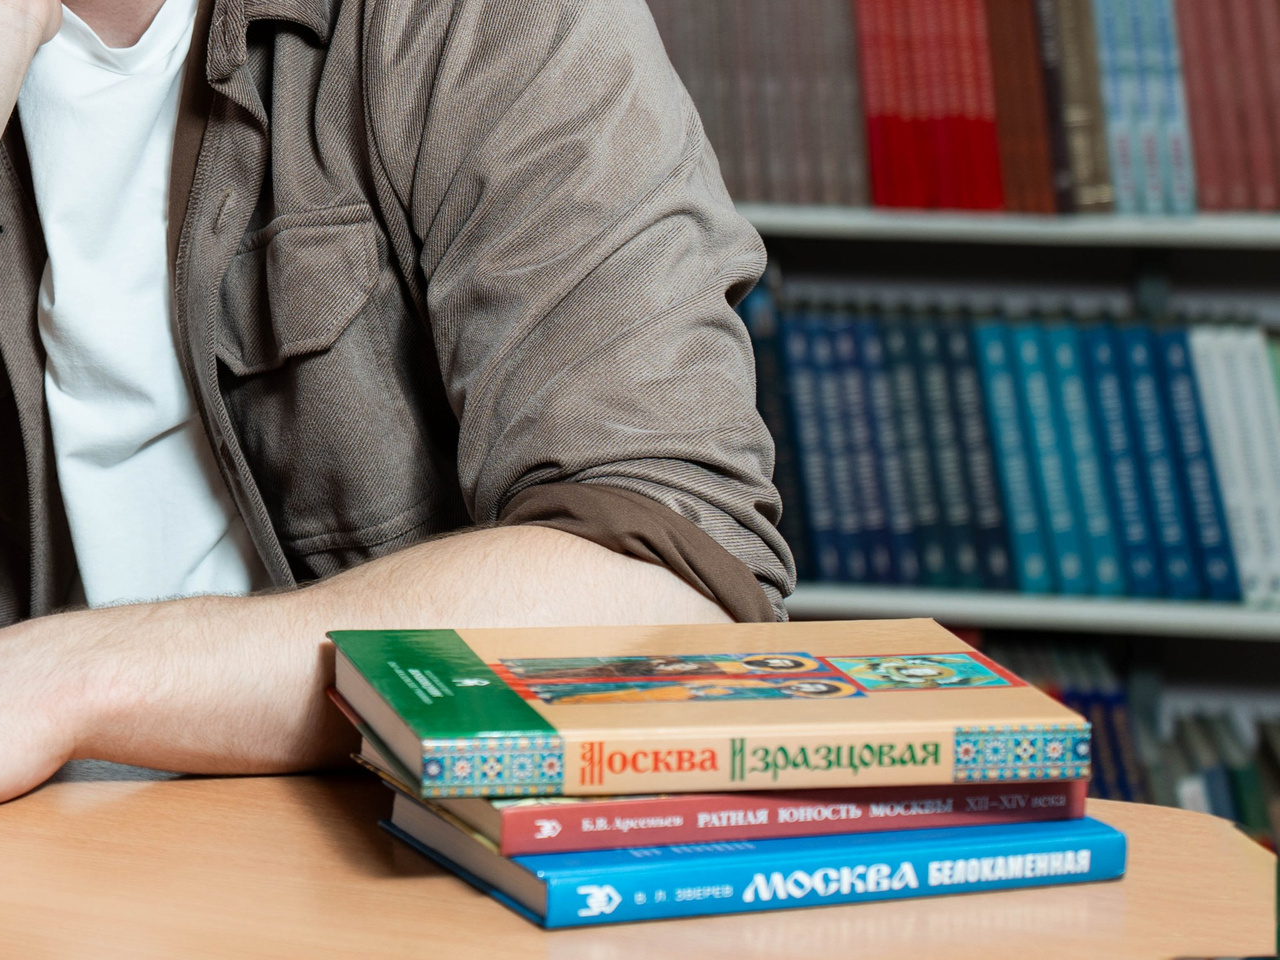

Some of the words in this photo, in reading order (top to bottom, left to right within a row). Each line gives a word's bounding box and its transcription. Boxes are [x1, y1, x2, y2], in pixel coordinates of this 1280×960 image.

[696, 809, 769, 828] РАТНАЯ
[777, 803, 863, 825] ЮНОСТЬ
[868, 797, 954, 819] МОСКВЫ
[1030, 793, 1067, 809] века
[741, 860, 920, 905] МОСКВА
[926, 848, 1093, 888] БЕЛОКАМЕННАЯ
